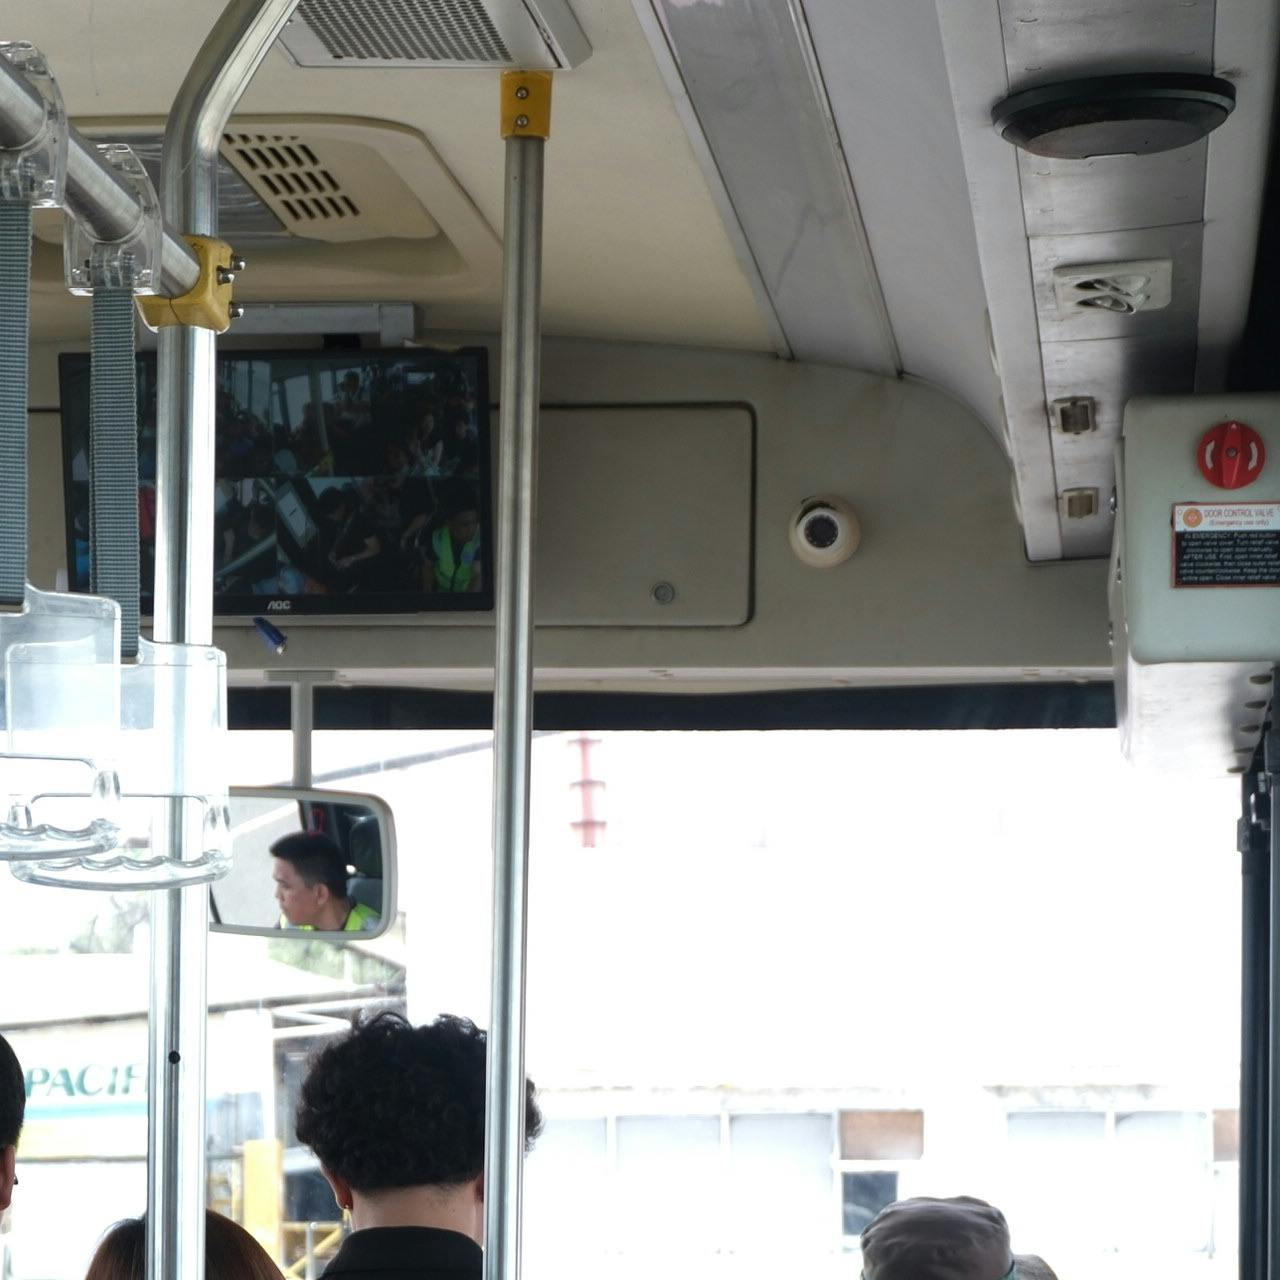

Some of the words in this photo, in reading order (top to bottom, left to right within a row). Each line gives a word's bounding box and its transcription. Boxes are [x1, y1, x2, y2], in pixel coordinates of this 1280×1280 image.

[1204, 509, 1222, 517] DOOR
[1224, 509, 1253, 517] CONTROL
[1255, 509, 1274, 517] VALVE
[267, 600, 291, 610] AOC
[24, 1063, 148, 1097] PACIF
